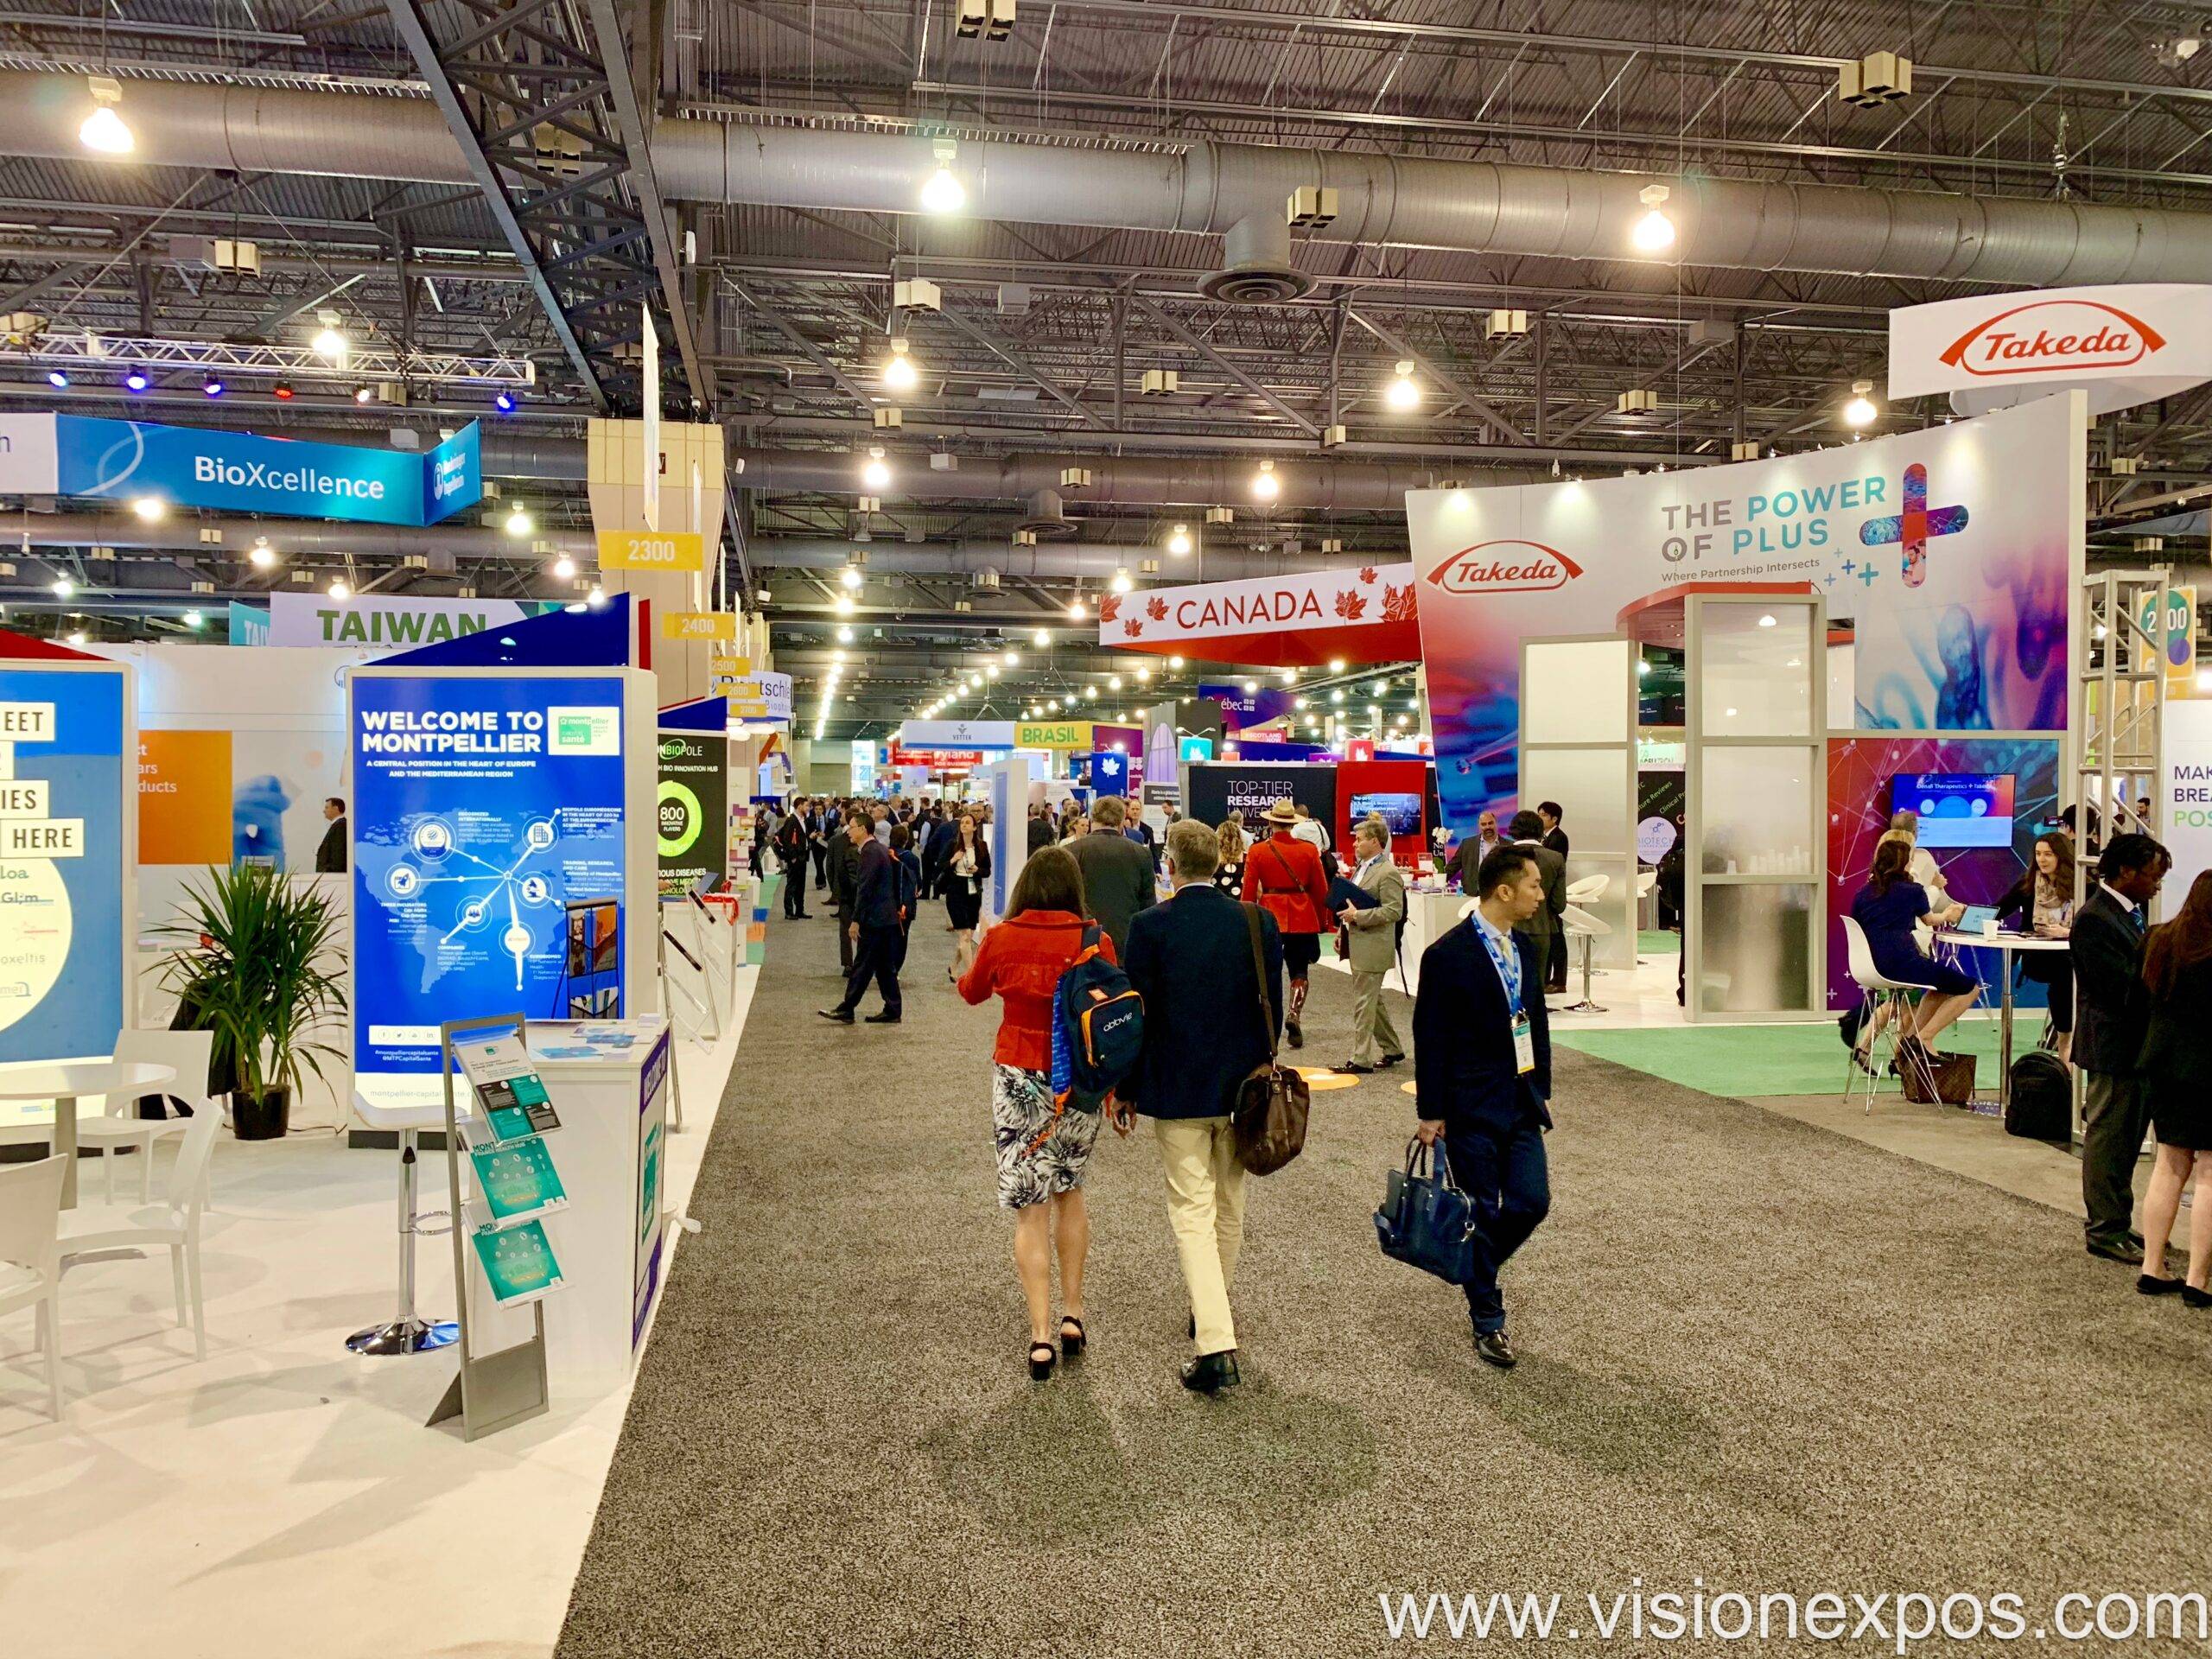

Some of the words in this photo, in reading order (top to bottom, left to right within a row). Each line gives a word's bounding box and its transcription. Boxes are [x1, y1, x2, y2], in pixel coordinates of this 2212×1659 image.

[1984, 325, 2132, 361] Takeda
[194, 455, 385, 500] BioXcellence
[1661, 499, 1733, 532] THE
[1747, 475, 1887, 523] POWER
[627, 539, 676, 562] 2300
[1661, 532, 1713, 563] OF
[1732, 518, 1830, 556] PLUS
[1457, 559, 1559, 583] Takeda
[1661, 571, 1698, 582] Where
[1700, 564, 1764, 580] Partnership
[1766, 558, 1821, 572] Intersects
[1176, 588, 1324, 630] CANADA
[2145, 606, 2188, 633] 200
[244, 620, 270, 645] TAI
[316, 608, 486, 644] TAIWAN
[681, 617, 715, 634] 2400
[711, 659, 737, 672] 2500
[1220, 696, 1243, 712] ébec
[3, 711, 44, 732] EET
[361, 710, 499, 731] WELCOME
[506, 710, 543, 731] TO
[362, 733, 542, 753] MONTPELLIER
[1021, 727, 1079, 743] BRASIL
[658, 744, 703, 757] NBIOPOLE
[138, 781, 178, 793] ducts
[1227, 780, 1294, 795] TOP-TIER
[1638, 798, 1651, 811] ture
[1649, 780, 1673, 804] Reviews
[2173, 787, 2212, 803] BRE
[2, 789, 37, 810] IES
[1659, 795, 1679, 816] Clinical
[1676, 790, 1686, 803] Pr
[659, 806, 685, 821] 800
[12, 827, 73, 849] HERE
[658, 868, 675, 877] IOUS
[675, 868, 707, 876] DISEASES
[1103, 1012, 1134, 1033] abbvie
